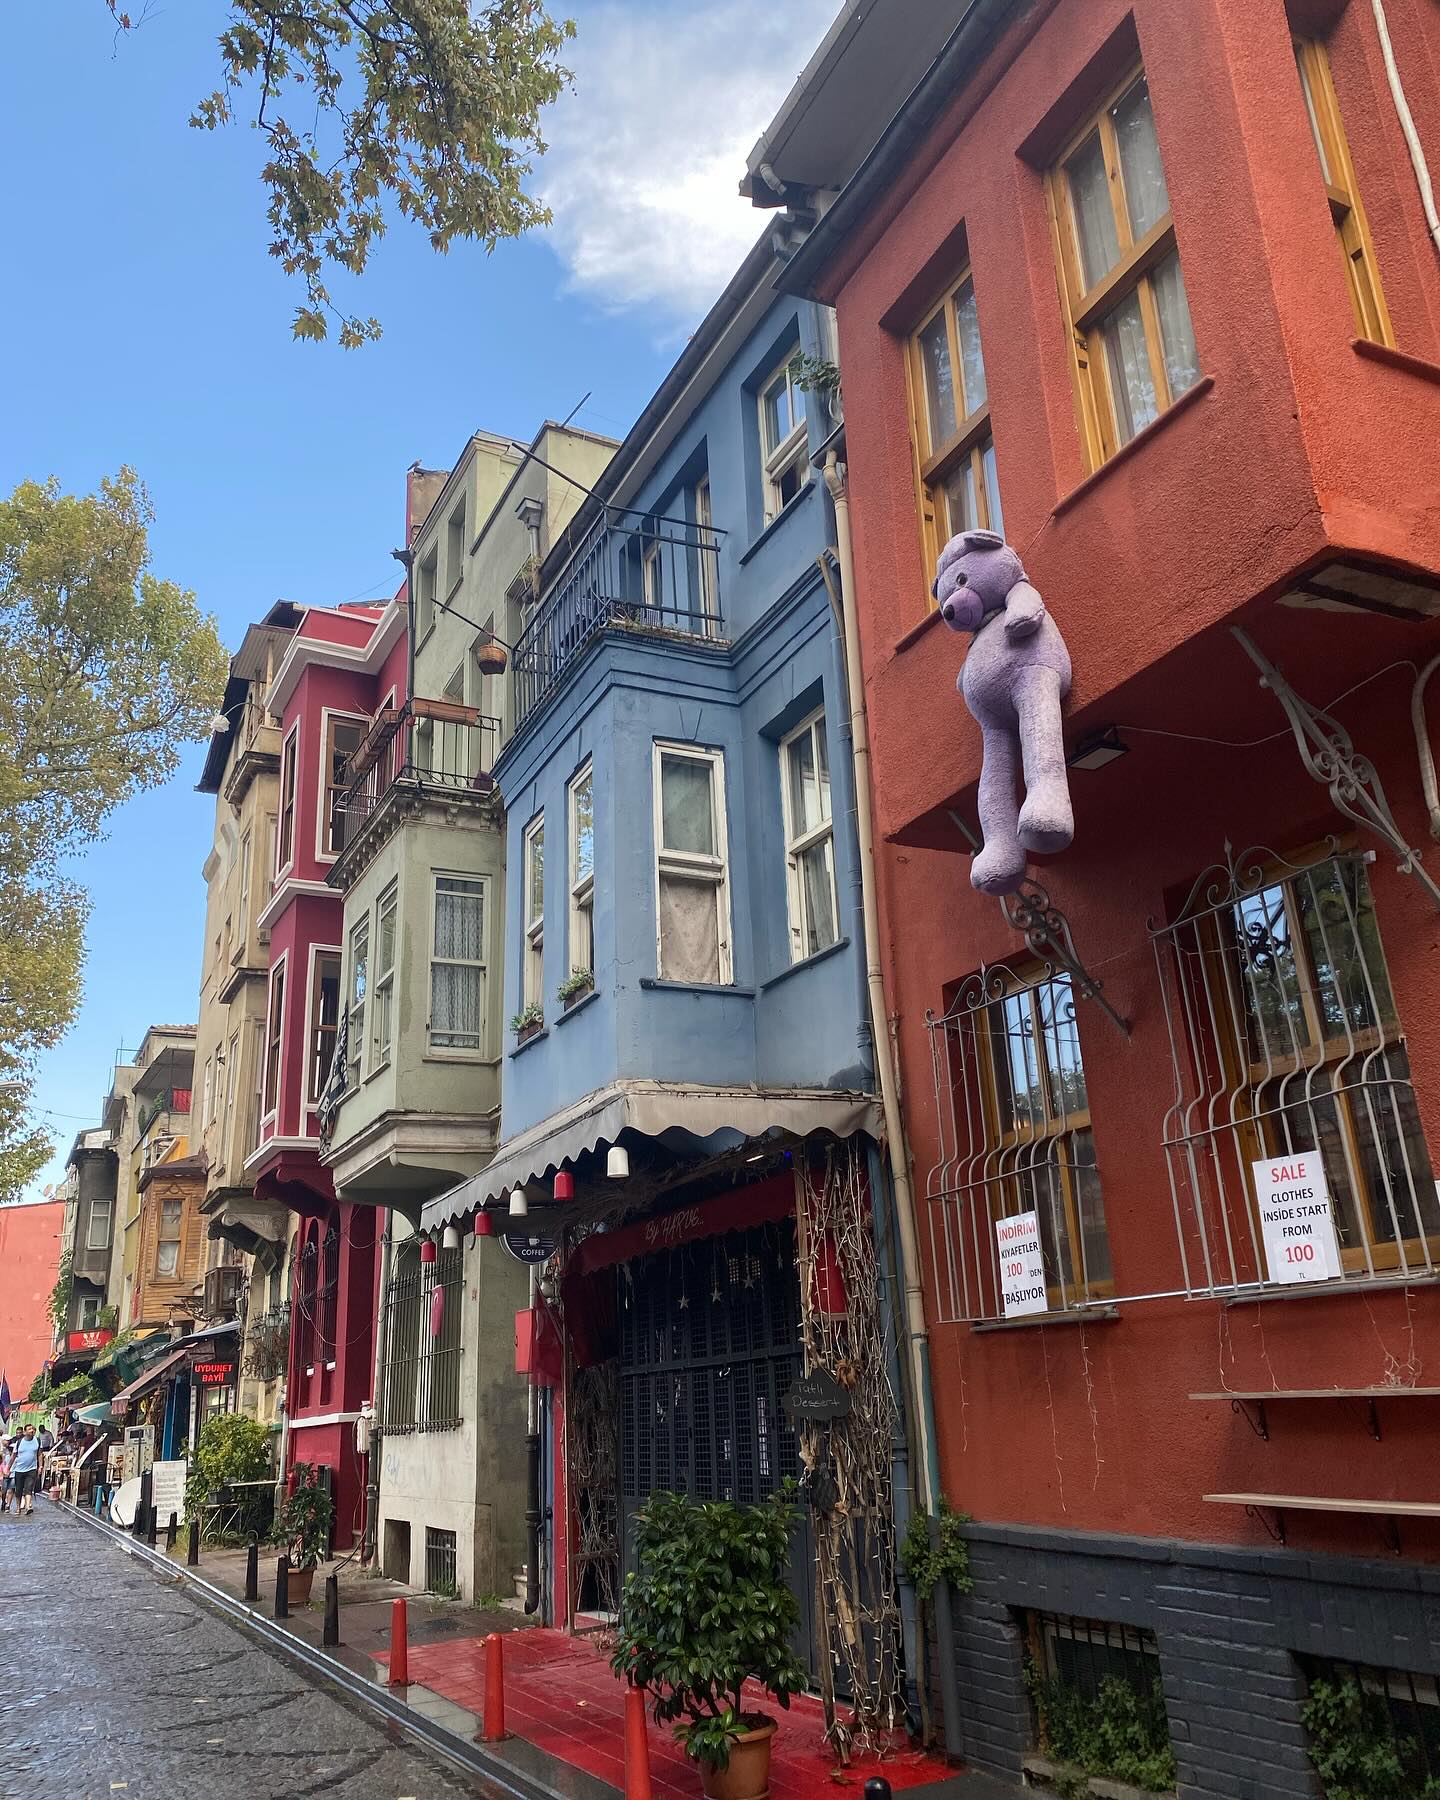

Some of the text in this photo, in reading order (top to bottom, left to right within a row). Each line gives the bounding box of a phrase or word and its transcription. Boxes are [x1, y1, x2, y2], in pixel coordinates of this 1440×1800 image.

[1271, 1163, 1306, 1183] SALE
[1271, 1187, 1314, 1204] CLOTHES
[1263, 1203, 1328, 1222] İNSİDE START
[998, 1221, 1036, 1242] İNDİRİM
[1282, 1224, 1313, 1238] FROM
[1001, 1241, 1039, 1260] KIYAFETLER
[1285, 1244, 1315, 1263] 100
[1007, 1262, 1023, 1278] 100
[1006, 1286, 1045, 1304] BAŞLIYOR
[791, 1395, 840, 1408] Dessert
